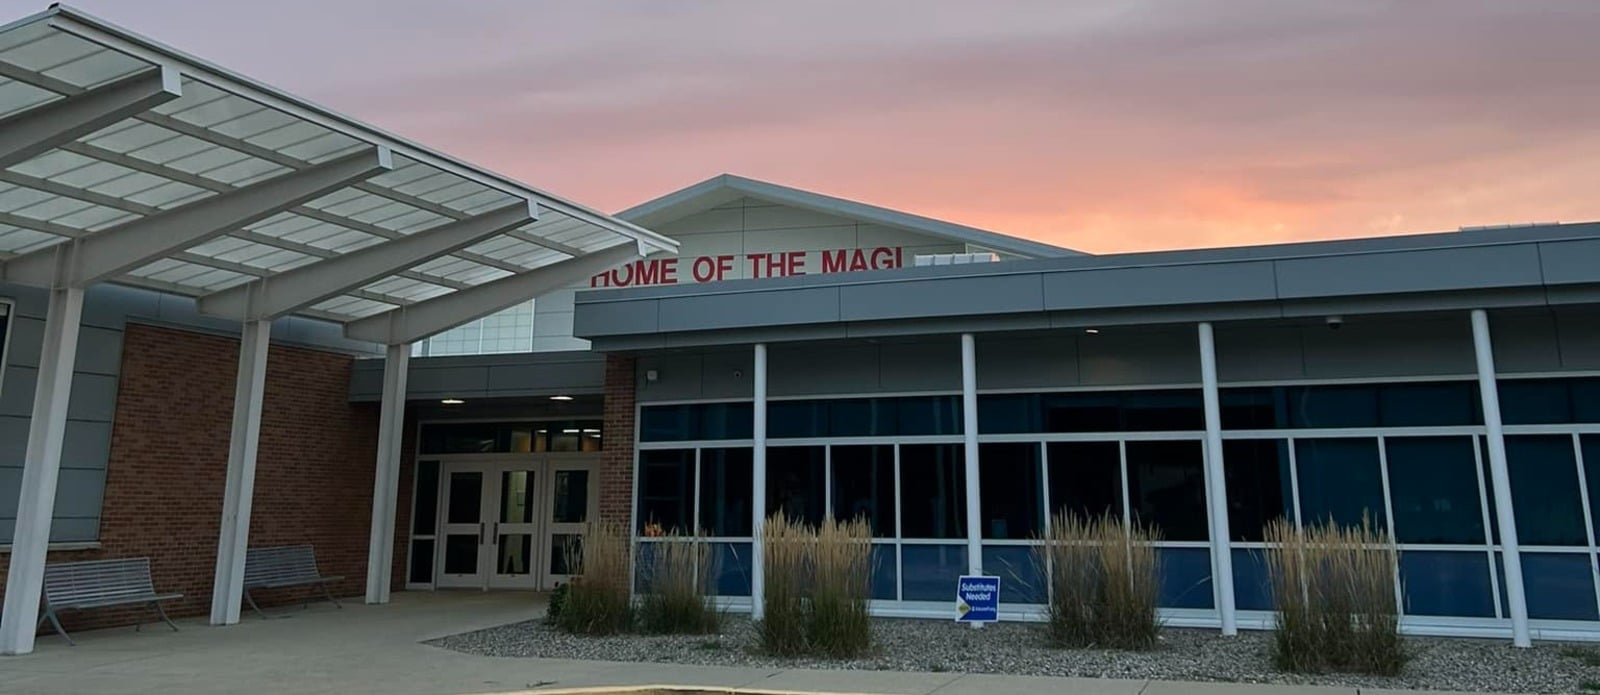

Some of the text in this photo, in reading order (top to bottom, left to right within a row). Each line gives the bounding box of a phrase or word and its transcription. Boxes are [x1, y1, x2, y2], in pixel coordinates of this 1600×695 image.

[693, 255, 734, 283] OF
[747, 251, 806, 279] THE
[822, 246, 902, 274] MAGI
[961, 582, 996, 592] Substitutes
[965, 592, 991, 601] Needed
